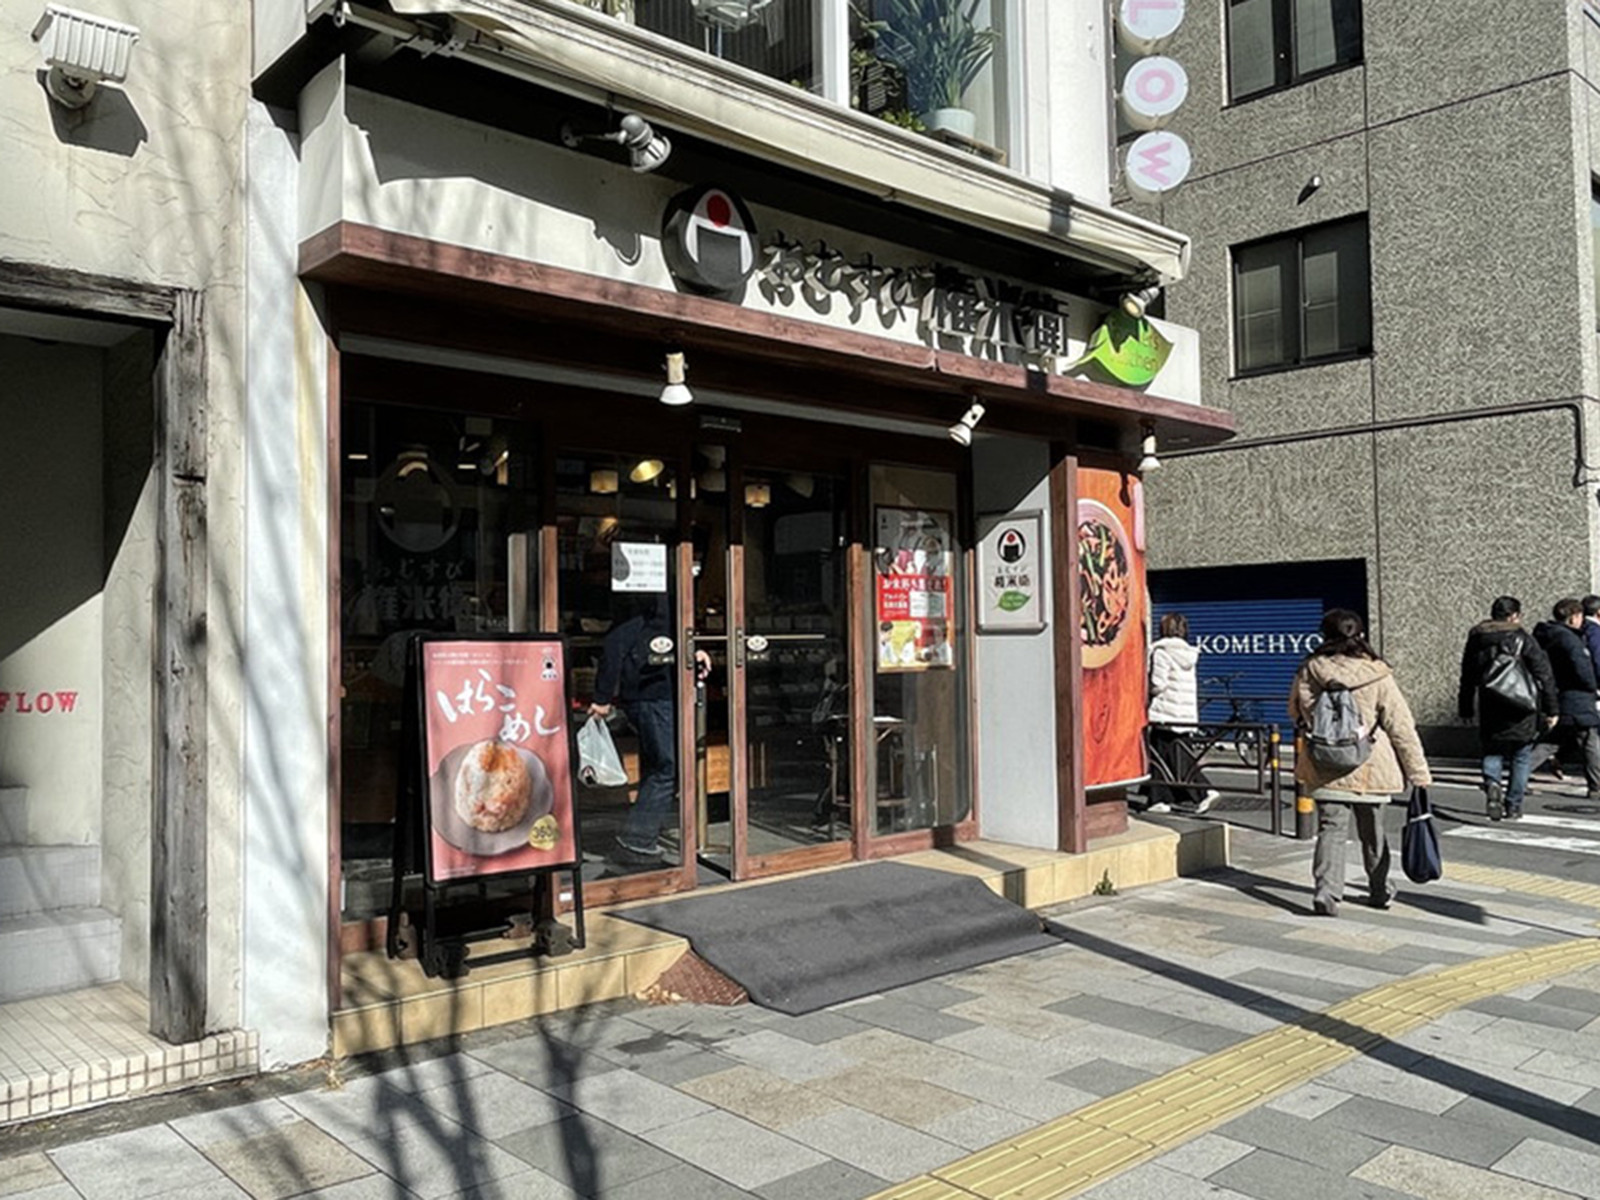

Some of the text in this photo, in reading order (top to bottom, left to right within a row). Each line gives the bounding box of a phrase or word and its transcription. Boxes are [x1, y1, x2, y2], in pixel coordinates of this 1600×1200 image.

[435, 668, 517, 723] はらこ
[498, 705, 561, 743] めし
